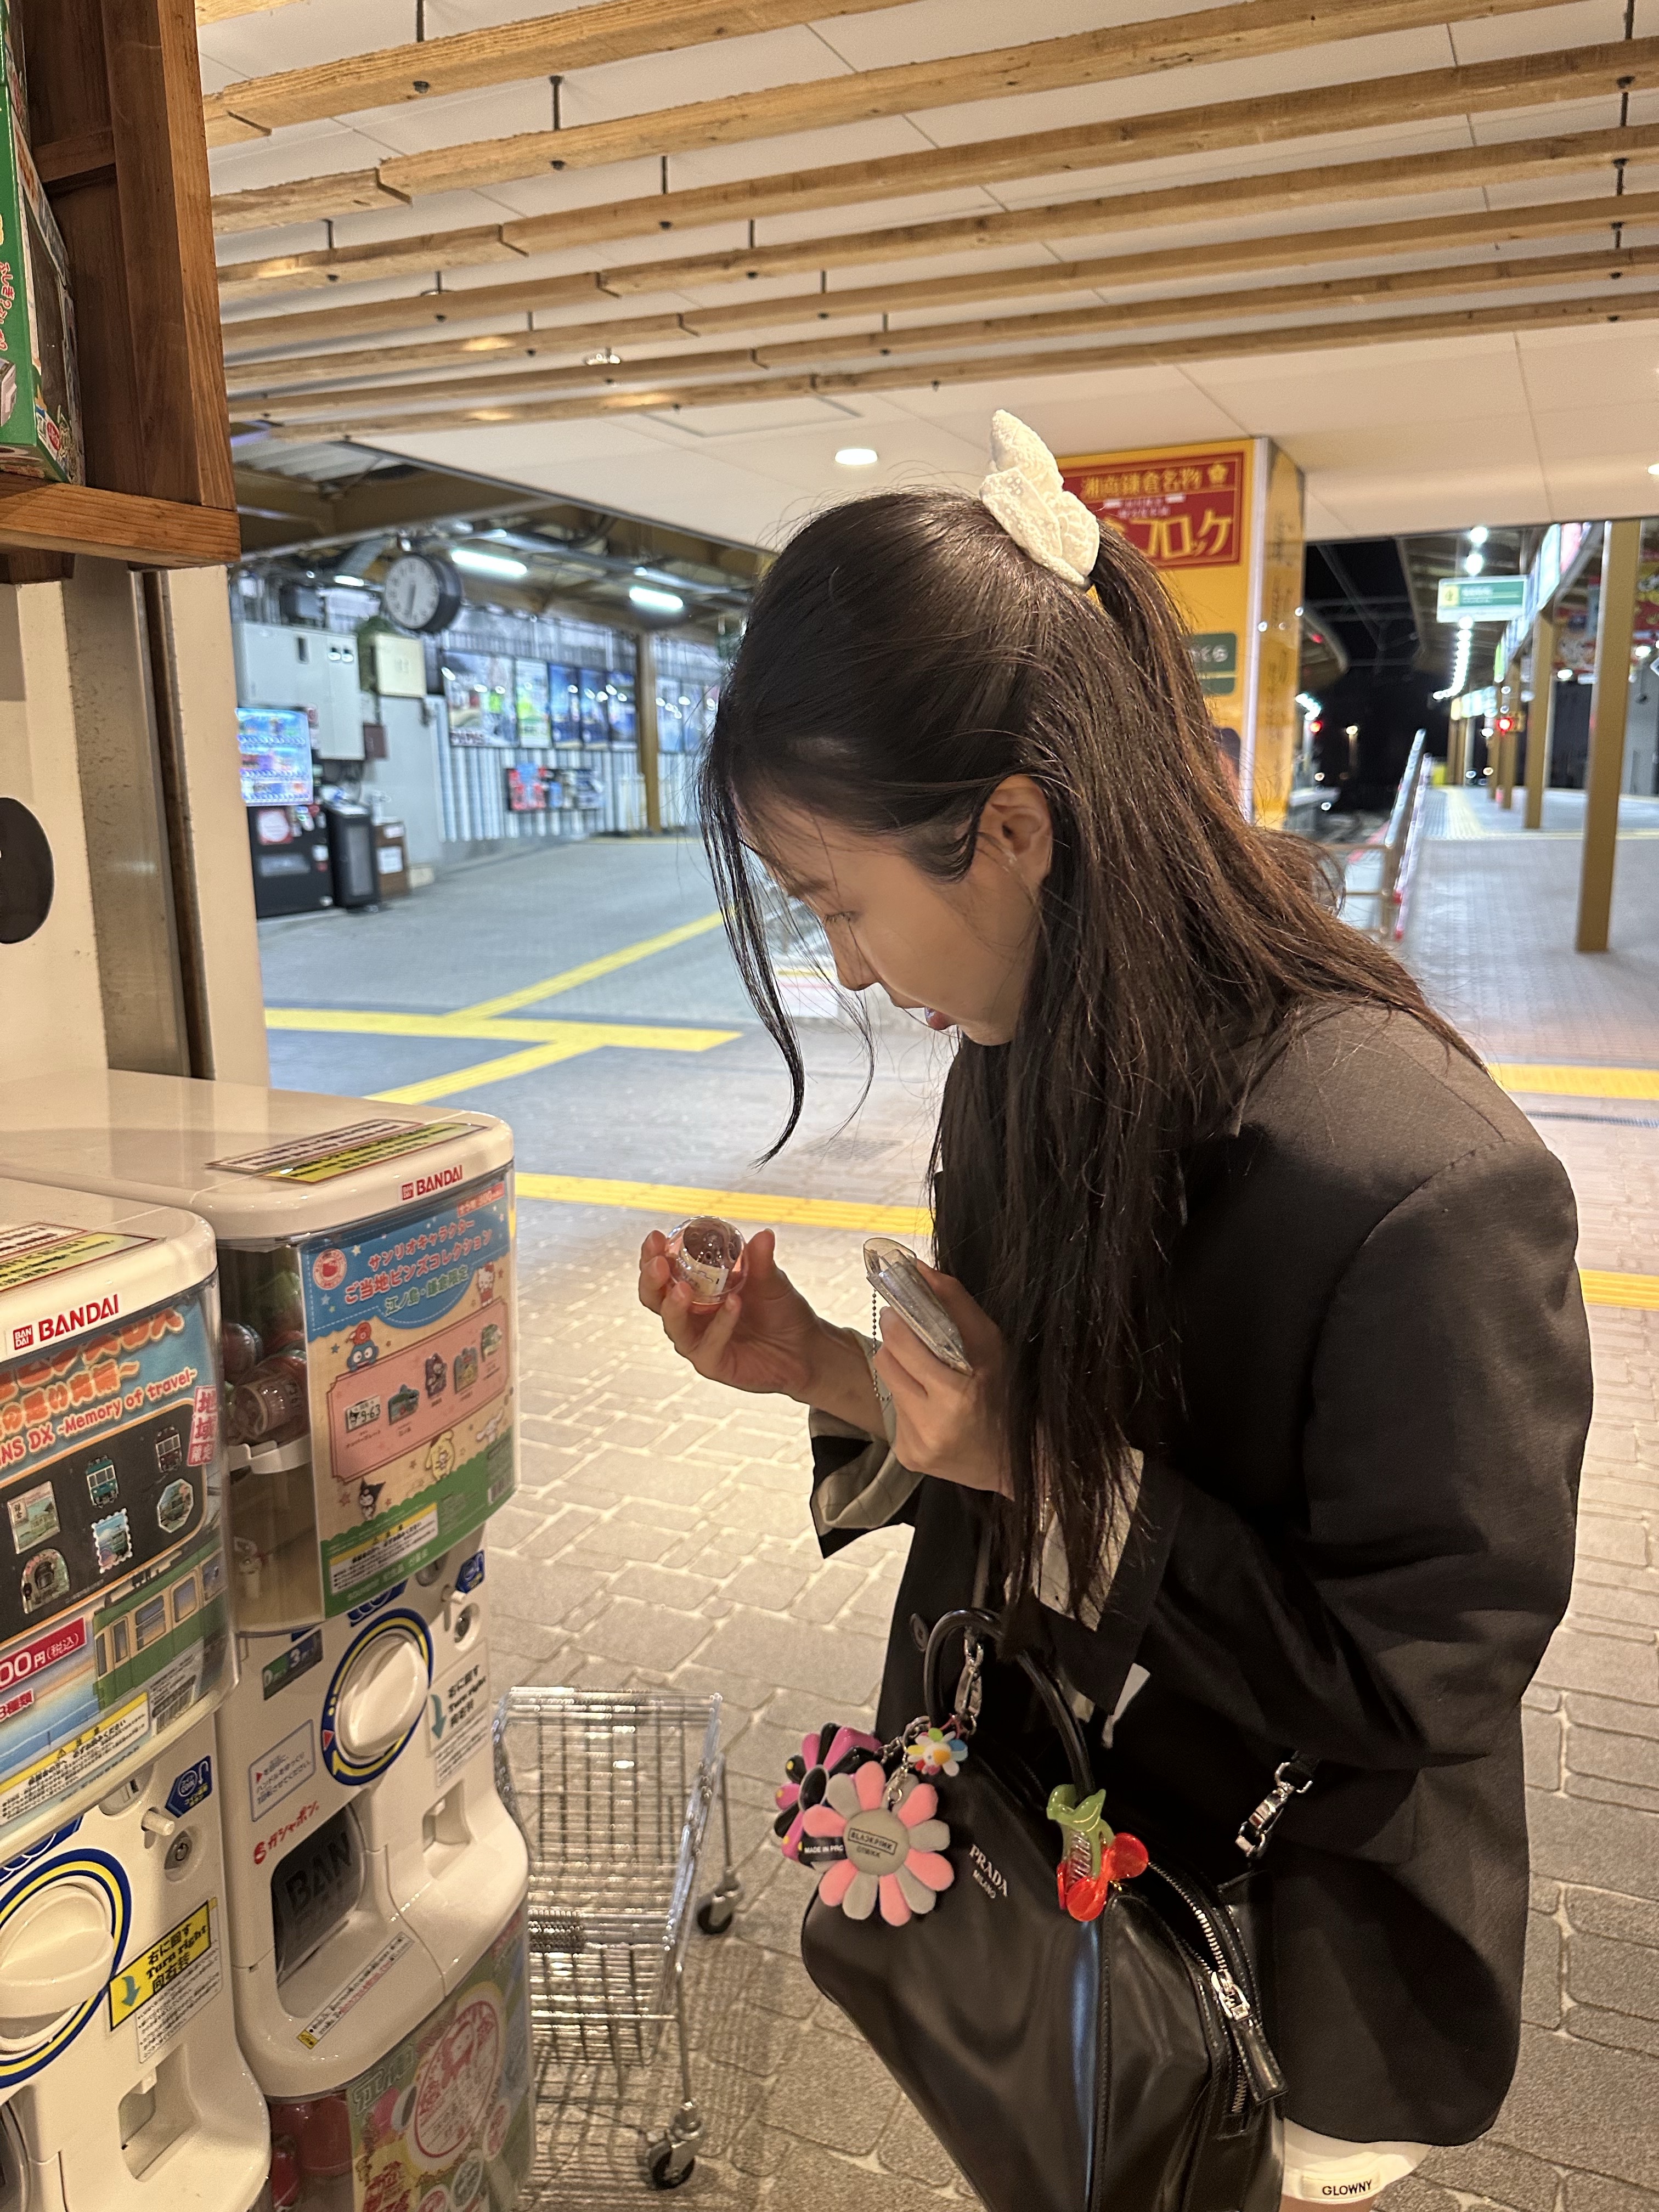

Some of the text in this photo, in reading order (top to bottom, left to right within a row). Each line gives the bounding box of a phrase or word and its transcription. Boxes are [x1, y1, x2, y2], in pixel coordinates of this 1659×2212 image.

[1104, 510, 1233, 558] コロッケ
[417, 1165, 462, 1196] BANDAI
[344, 1229, 493, 1305] ご当地ピンズコレクション
[369, 1218, 475, 1271] サンリオキャラクター
[39, 1294, 119, 1341] BANDAI
[29, 1422, 54, 1449] DX
[124, 1386, 143, 1408] of
[969, 1844, 1008, 1897] PRADA
[972, 1870, 996, 1898] MILANO
[146, 1926, 207, 1978] Turn right
[148, 1923, 191, 1965] 右に回す
[1322, 2179, 1372, 2196] GLOWNY
